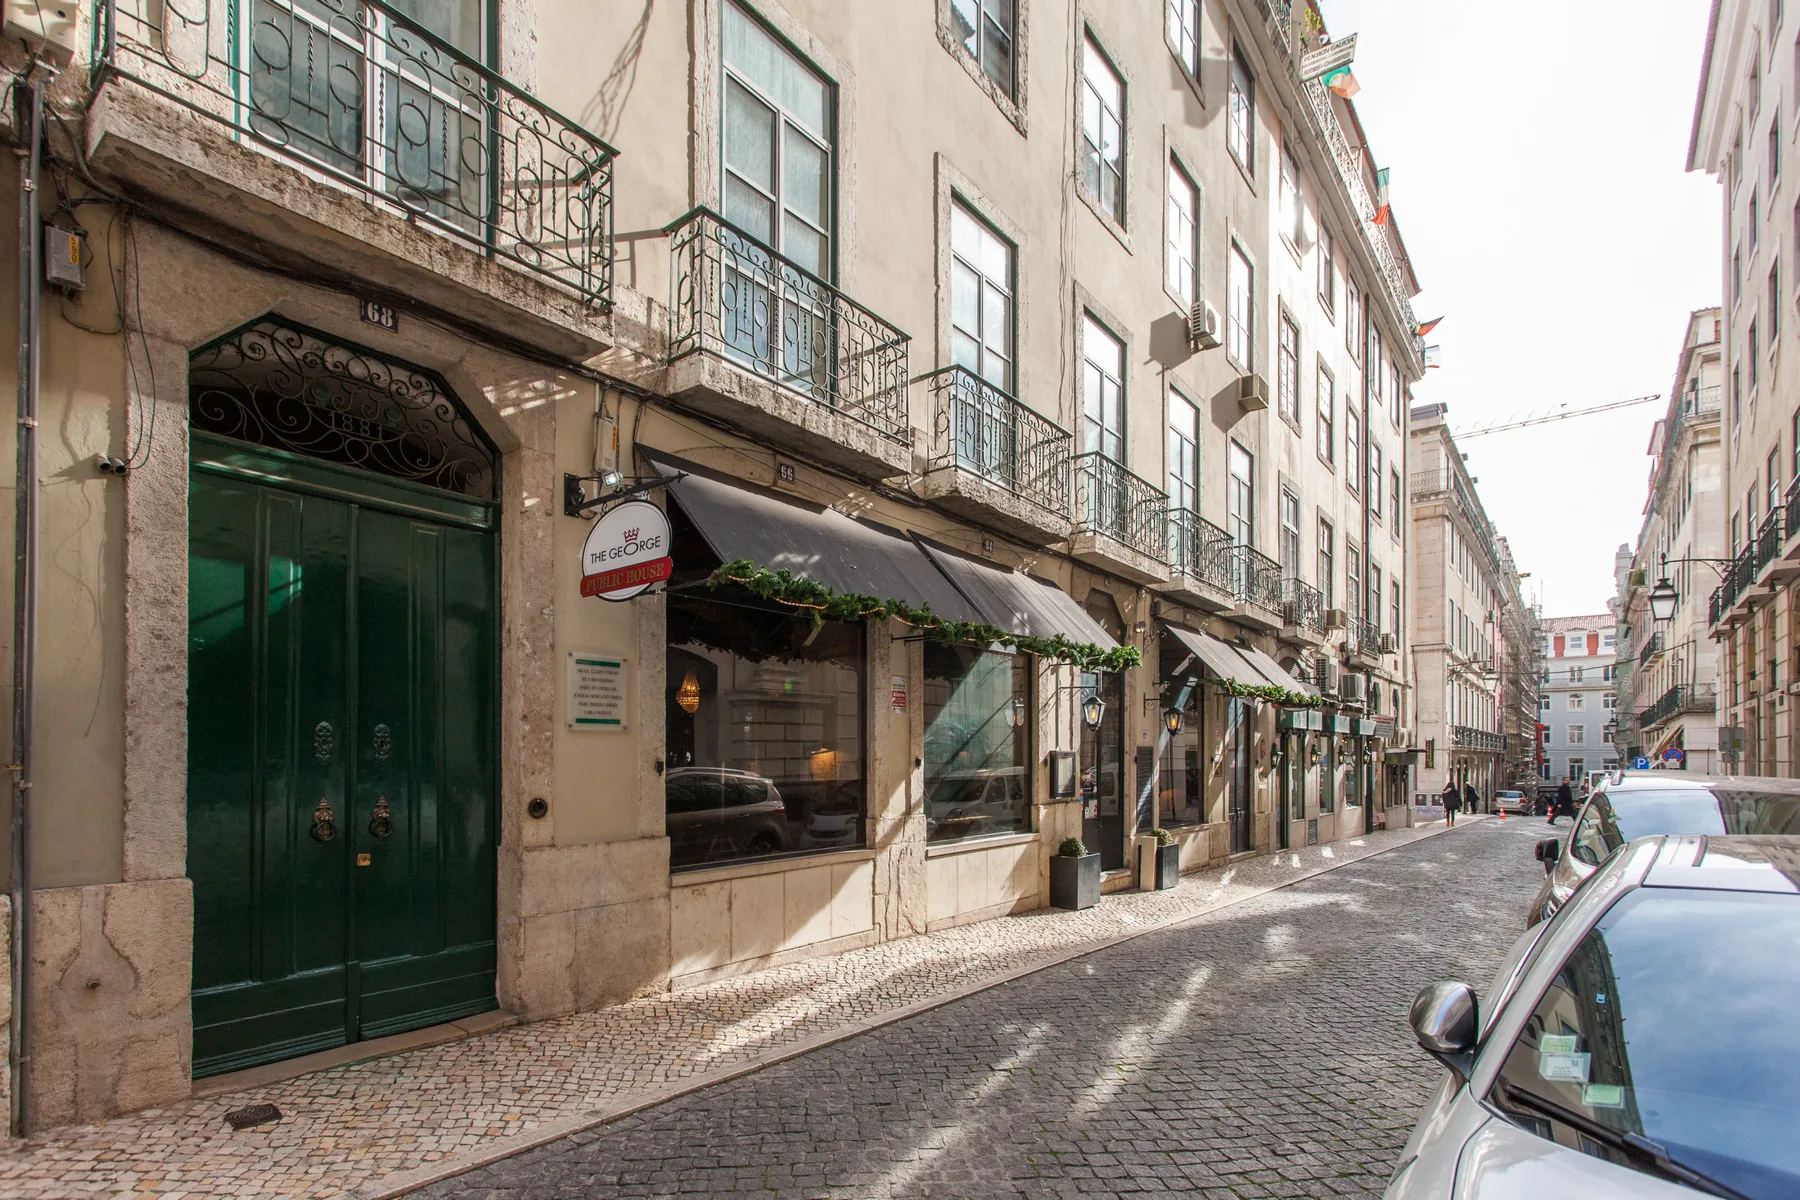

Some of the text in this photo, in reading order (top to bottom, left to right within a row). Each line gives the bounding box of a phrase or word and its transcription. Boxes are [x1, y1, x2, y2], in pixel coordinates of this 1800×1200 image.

[367, 301, 393, 328] 68
[328, 410, 383, 440] 1881
[590, 535, 661, 564] THE GEORGE
[586, 563, 664, 593] PUBLIC HOUSE
[1637, 758, 1646, 769] P
